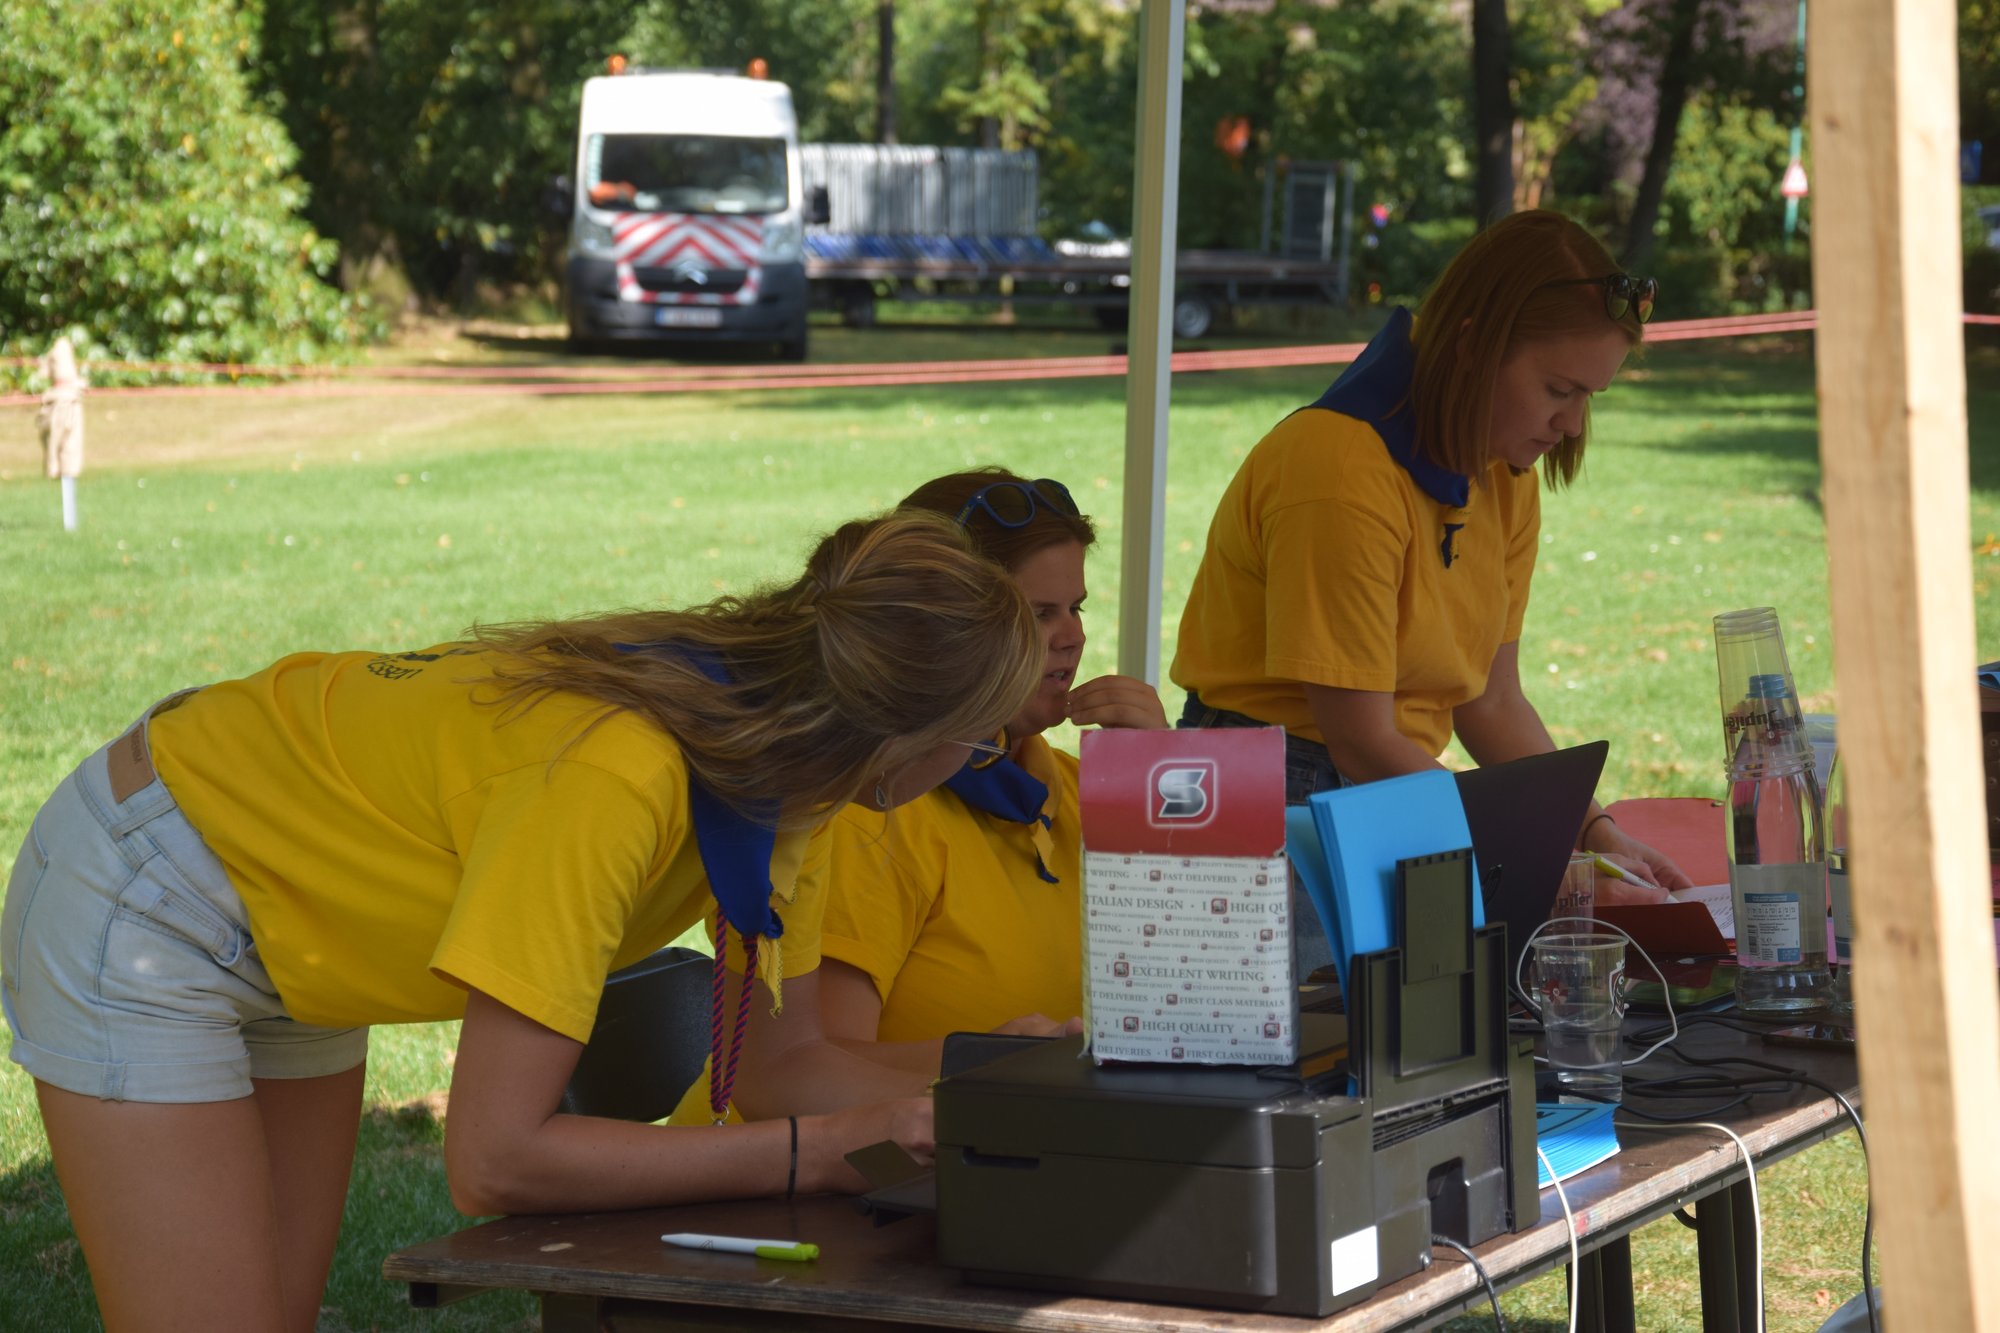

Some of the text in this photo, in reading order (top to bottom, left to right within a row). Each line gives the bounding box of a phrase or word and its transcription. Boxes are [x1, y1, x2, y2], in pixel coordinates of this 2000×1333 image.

[1090, 868, 1130, 878] WRITING
[1163, 872, 1183, 881] FAST
[1186, 874, 1238, 884] DELIVERIES
[1136, 898, 1184, 910] DESIGN
[1230, 902, 1265, 914] HIGH
[1158, 927, 1180, 936] FAST
[1183, 928, 1240, 939] DELIVERIES
[1132, 966, 1204, 980] EXCELLENT
[1206, 969, 1264, 982] WRITING
[1099, 992, 1149, 1002] DELIVERIES
[1180, 996, 1204, 1005] FIRST
[1206, 998, 1233, 1006] CLASS
[1234, 999, 1285, 1008] MATERIALS
[1142, 1020, 1176, 1032] HIGH
[1180, 1022, 1234, 1034] QUALITY
[1097, 1044, 1152, 1056] DELIVERIES
[1186, 1049, 1213, 1058] FIRST
[1215, 1050, 1245, 1060] CLASS
